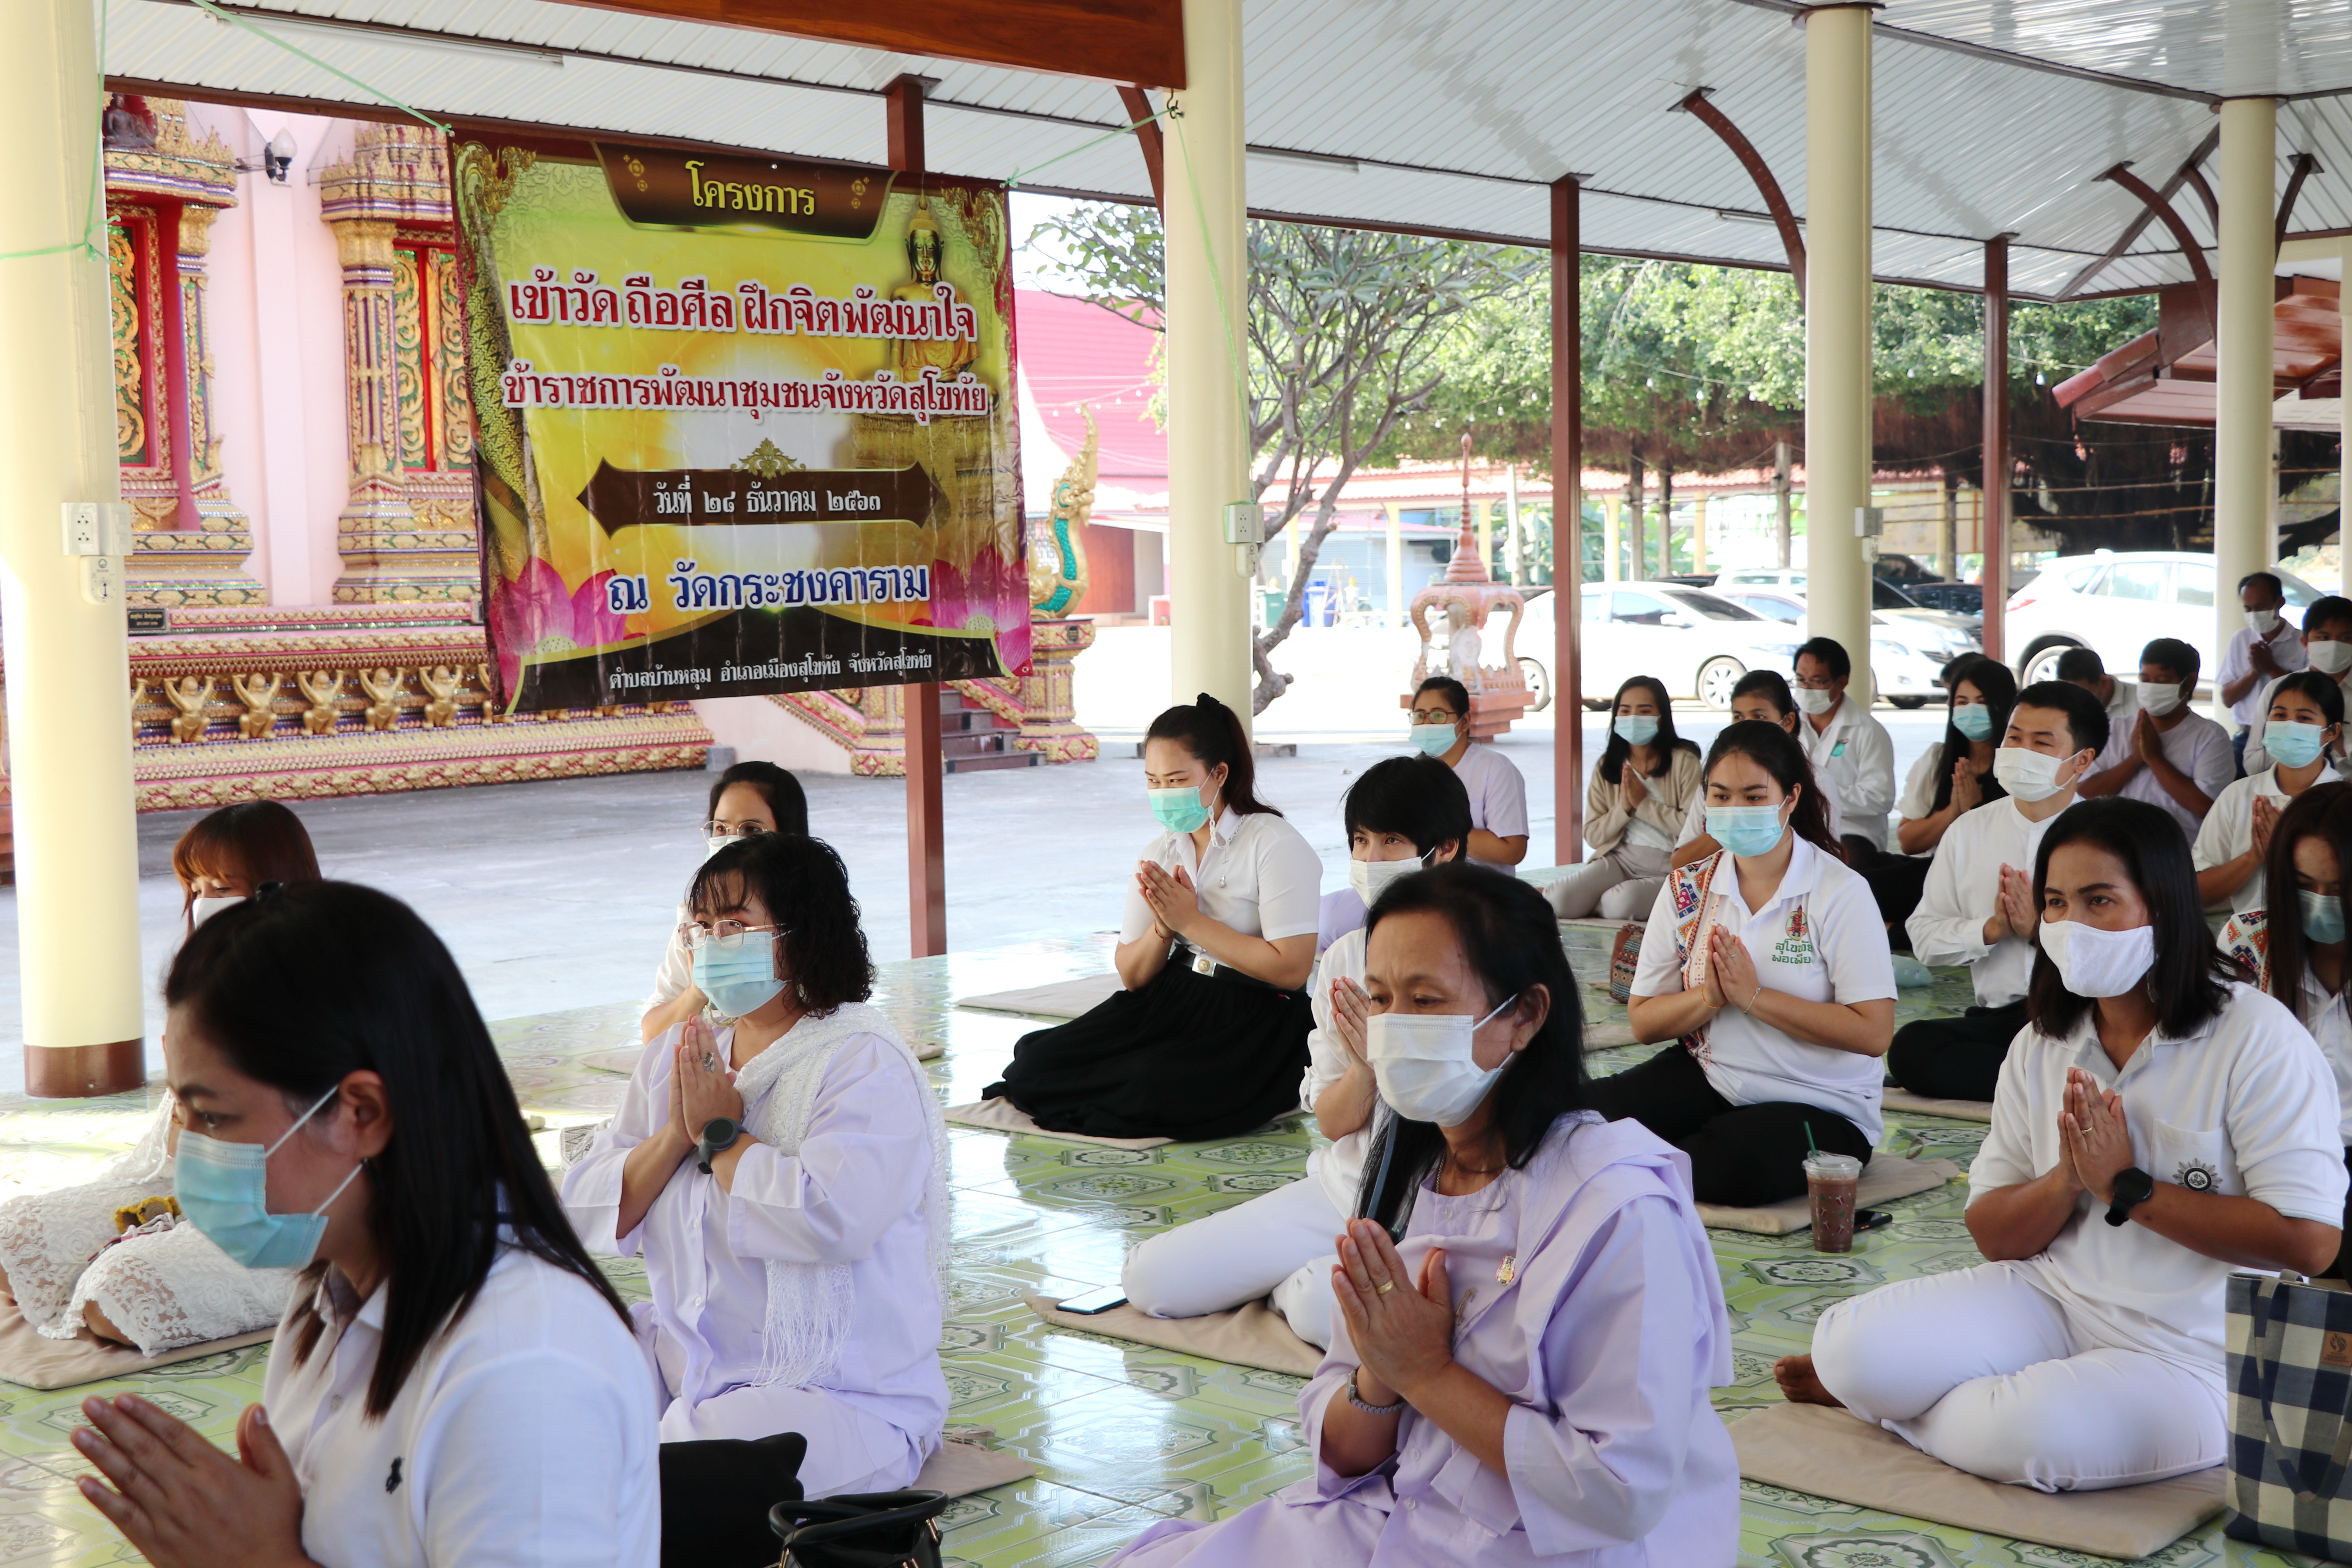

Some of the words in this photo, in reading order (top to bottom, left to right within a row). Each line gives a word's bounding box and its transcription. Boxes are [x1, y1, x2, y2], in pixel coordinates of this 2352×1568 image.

[685, 160, 815, 215] โครงการ
[511, 269, 619, 323] เข้าวัด
[625, 275, 733, 328] ถือศีล
[739, 283, 975, 338] ฝึกจิตพัฒนาใจ
[505, 362, 987, 422] ข้าราชการพัฒนาชุมชนจังหวัดสุโขทัย
[653, 475, 692, 514] วันที่
[703, 491, 736, 513] ๒๘
[746, 481, 817, 512] ธันวาคม
[826, 490, 881, 511] ๒๕๖๓
[610, 577, 648, 610] ณ
[670, 561, 928, 609] วัดกระชงคาราม
[609, 664, 711, 690] ตำบลบ้านหลุม
[720, 652, 841, 682] อำเภอเมืองสุโขทัย
[848, 647, 932, 676] จังหวัดสุโขทัย
[1771, 953, 1813, 964] พอเพีย
